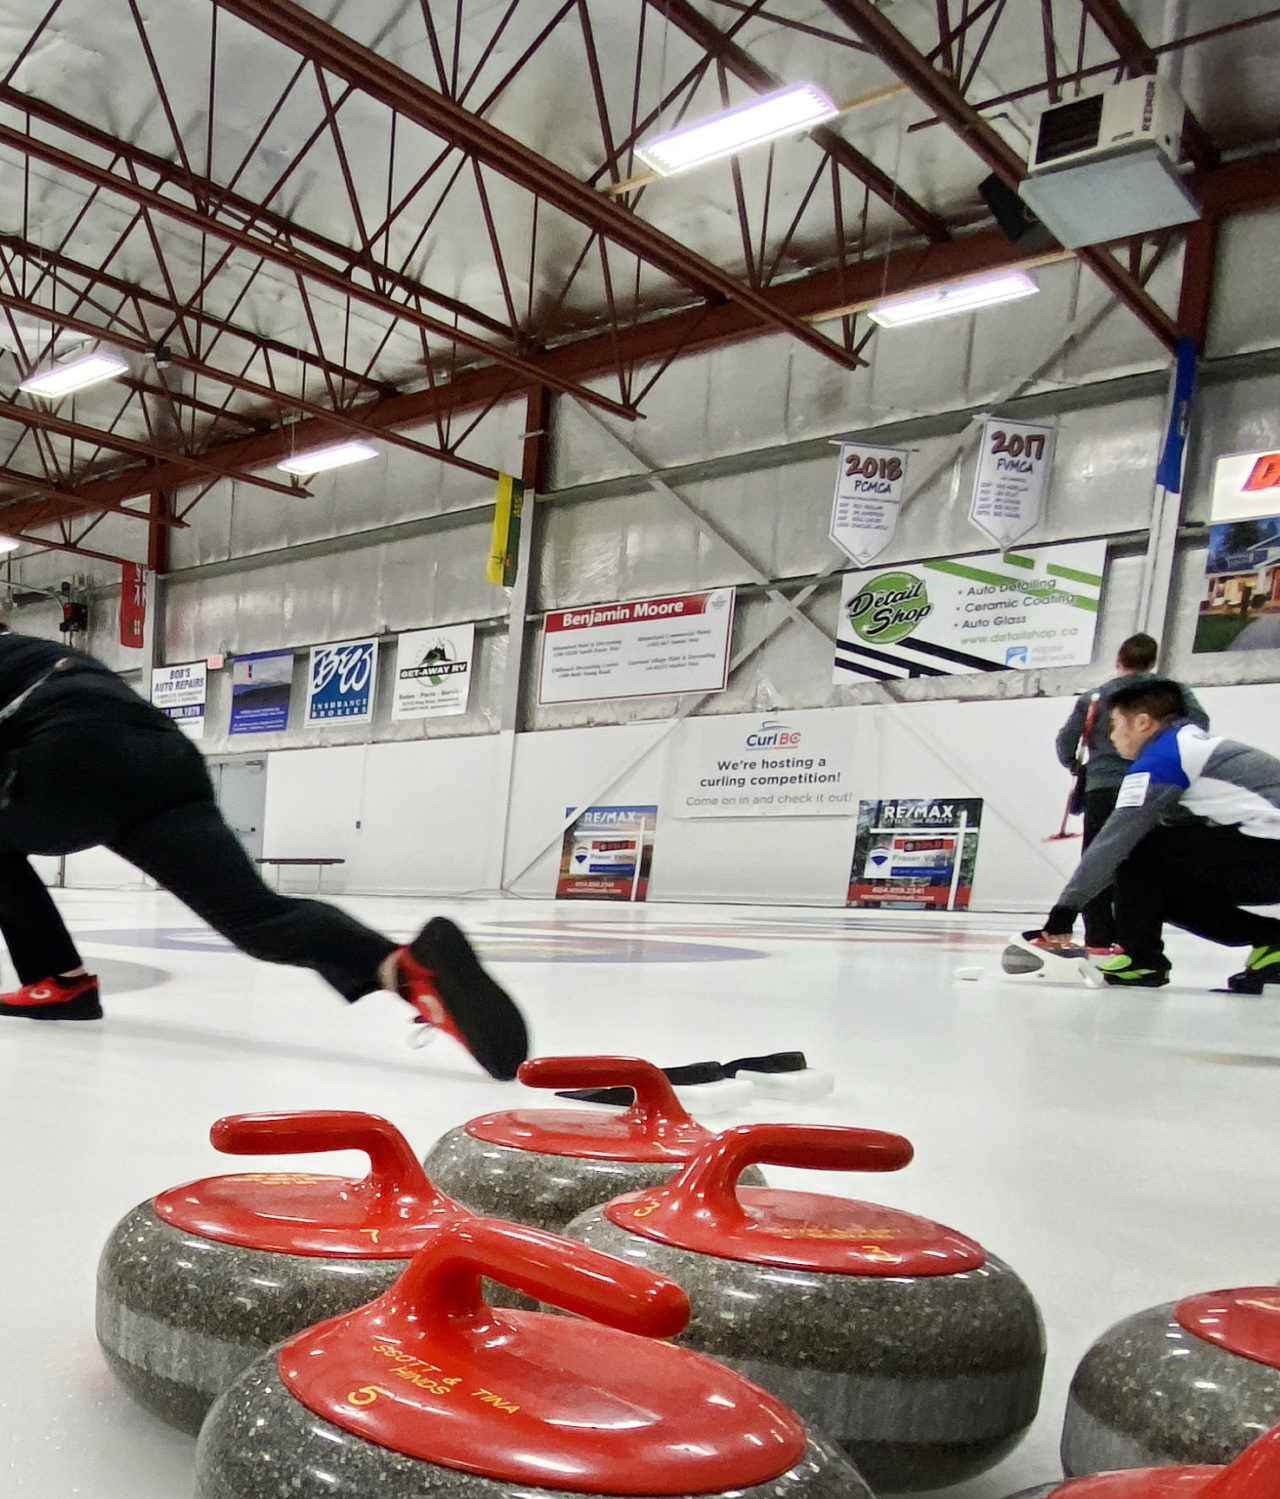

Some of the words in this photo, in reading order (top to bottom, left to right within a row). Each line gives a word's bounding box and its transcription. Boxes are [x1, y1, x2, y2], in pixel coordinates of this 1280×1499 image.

[991, 431, 1045, 460] 2017
[846, 454, 903, 481] 2018
[997, 458, 1033, 474] FVMCA
[855, 480, 891, 494] PCMCA
[967, 586, 996, 596] Auto
[1000, 579, 1056, 592] Detailing
[847, 582, 923, 618] Detail
[965, 599, 1019, 612] Ceramic
[1023, 594, 1075, 606] Coating
[562, 606, 630, 627] Benjamin
[633, 601, 684, 618] Moore
[867, 604, 933, 635] Shop
[962, 618, 990, 628] Auto
[993, 616, 1027, 626] Glass
[170, 668, 191, 680] BOB'S
[401, 665, 450, 678] GET-AWAY
[451, 663, 466, 673] RV
[155, 682, 174, 693] AUTO
[175, 678, 204, 691] REPAIRS
[311, 707, 368, 718] BROKERS
[312, 698, 367, 711] INSURANCE
[746, 733, 778, 748] Curl
[779, 731, 802, 745] BC
[717, 759, 757, 771] We're
[761, 757, 813, 769] hosting
[818, 758, 826, 767] a
[700, 775, 746, 788] curling
[750, 772, 841, 786] competition!
[686, 796, 718, 806] Come
[721, 797, 737, 806] on
[739, 796, 749, 805] in
[752, 795, 774, 805] and
[777, 792, 812, 804] check
[816, 793, 824, 803] it
[828, 793, 853, 803] out!
[584, 811, 637, 823] RE/MAX
[884, 804, 954, 819] RE/MAX
[359, 1228, 380, 1244] 7
[373, 1344, 442, 1372] SCOTT
[442, 1377, 462, 1386] &
[471, 1388, 520, 1414] TINA
[388, 1366, 451, 1395] HINDS
[347, 1385, 388, 1406] 5
